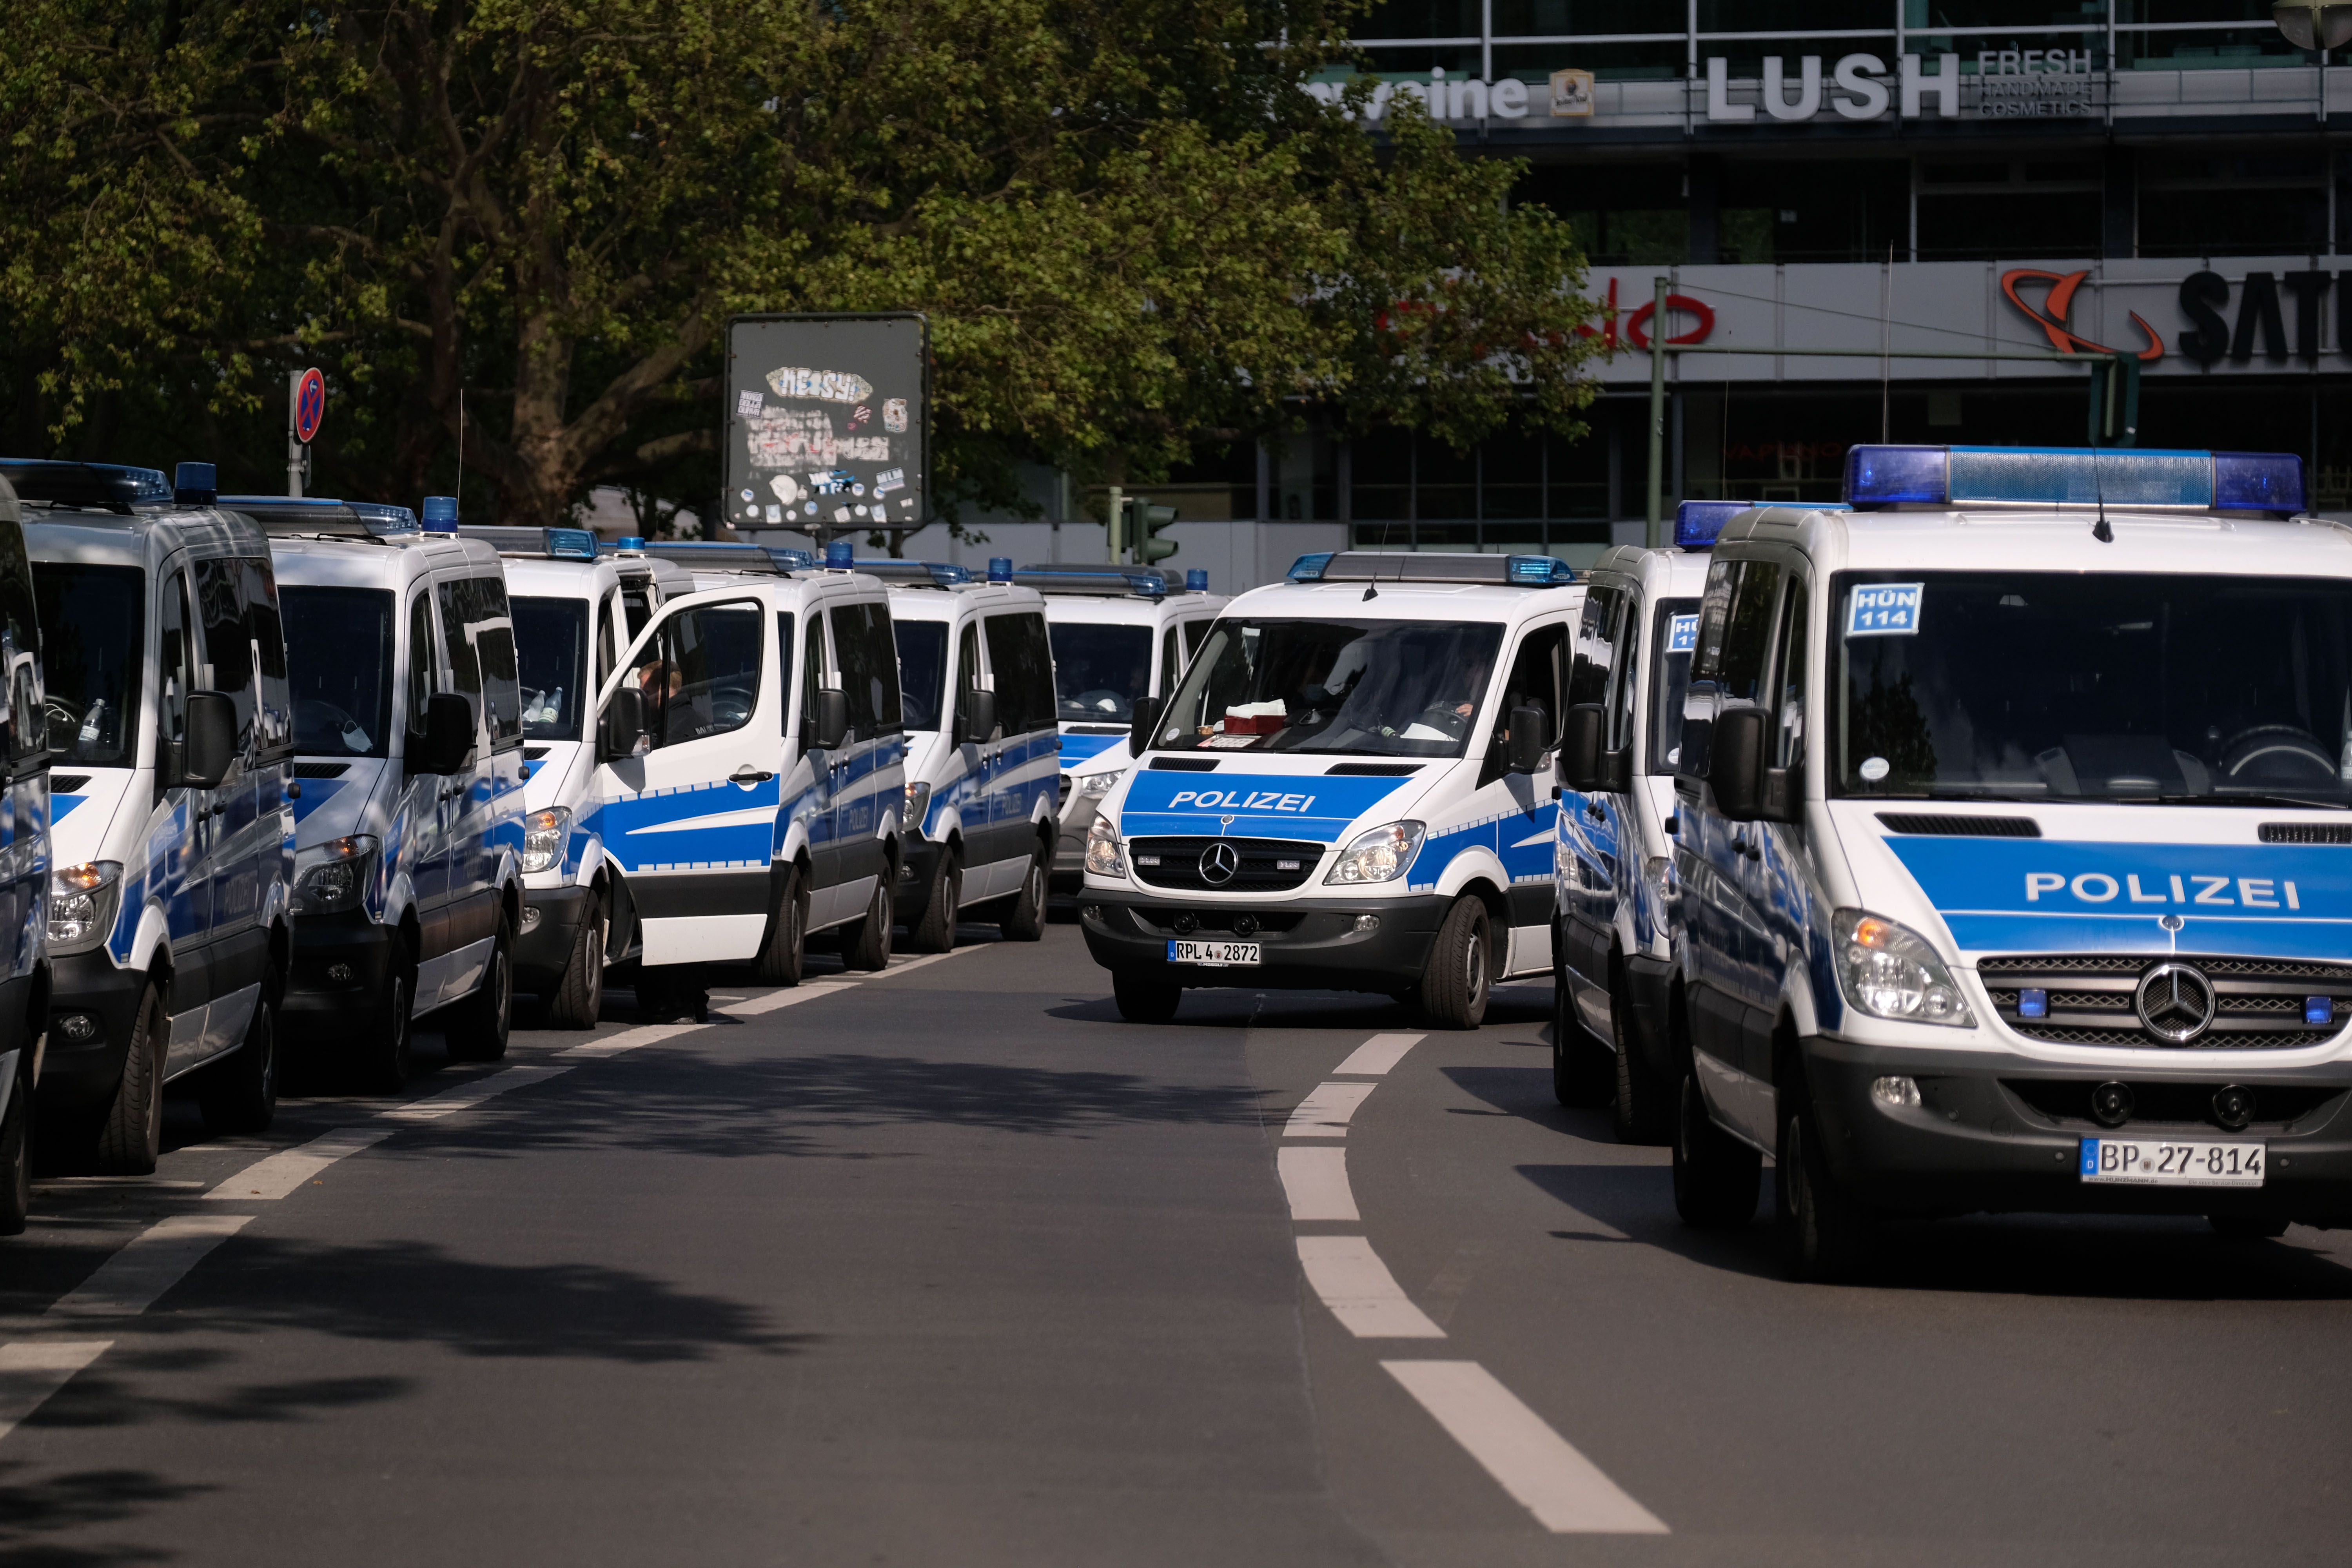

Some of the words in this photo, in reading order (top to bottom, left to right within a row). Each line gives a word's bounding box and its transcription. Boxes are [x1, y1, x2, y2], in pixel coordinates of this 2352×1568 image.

[1978, 49, 2091, 75] FRESH
[1707, 53, 1960, 121] LUSH
[1979, 80, 2092, 96] HANDMADE
[1980, 100, 2092, 117] COSMETICS
[1857, 591, 1916, 608] HÜN
[1860, 611, 1908, 626] 114
[1168, 790, 1316, 813] POLIZEI
[849, 806, 869, 831] POLIZEI
[2025, 872, 2301, 910] POLIZEI
[1176, 943, 1202, 960] RPL
[1206, 944, 1213, 960] 4
[1224, 945, 1258, 961] 2872
[2087, 1160, 2094, 1169] D
[2101, 1143, 2140, 1172] BP
[2158, 1143, 2262, 1175] 27-814
